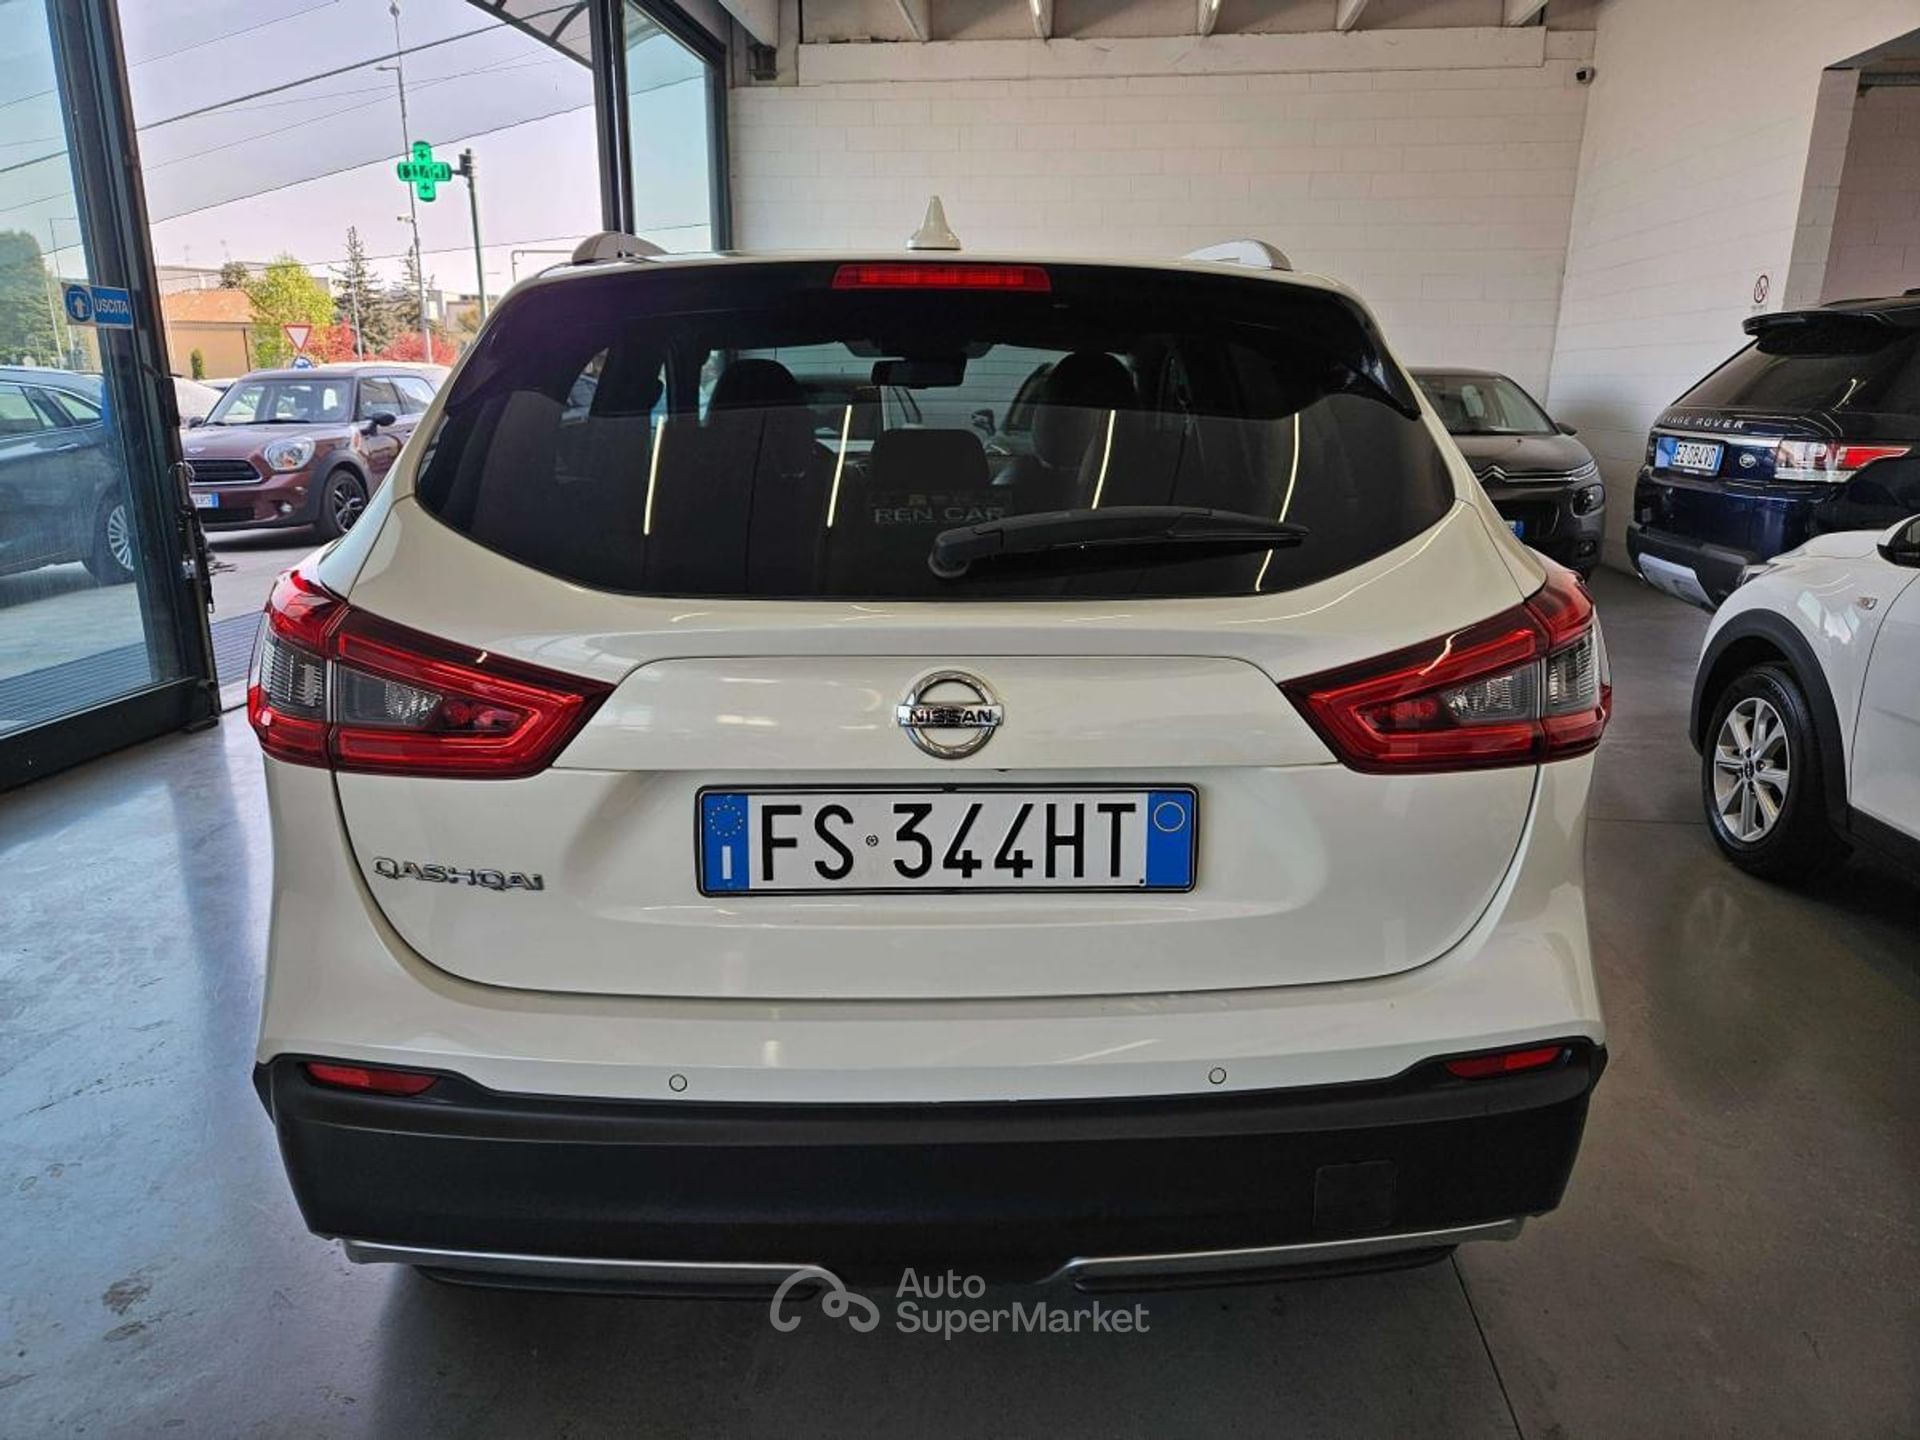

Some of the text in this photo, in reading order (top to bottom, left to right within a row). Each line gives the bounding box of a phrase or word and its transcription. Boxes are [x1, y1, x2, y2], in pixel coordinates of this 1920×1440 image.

[94, 297, 129, 314] USCITA
[1696, 417, 1745, 429] ROVER
[909, 709, 993, 723] NISSAN
[761, 802, 1137, 881] FS 344HT
[373, 856, 545, 891] QASHQAI
